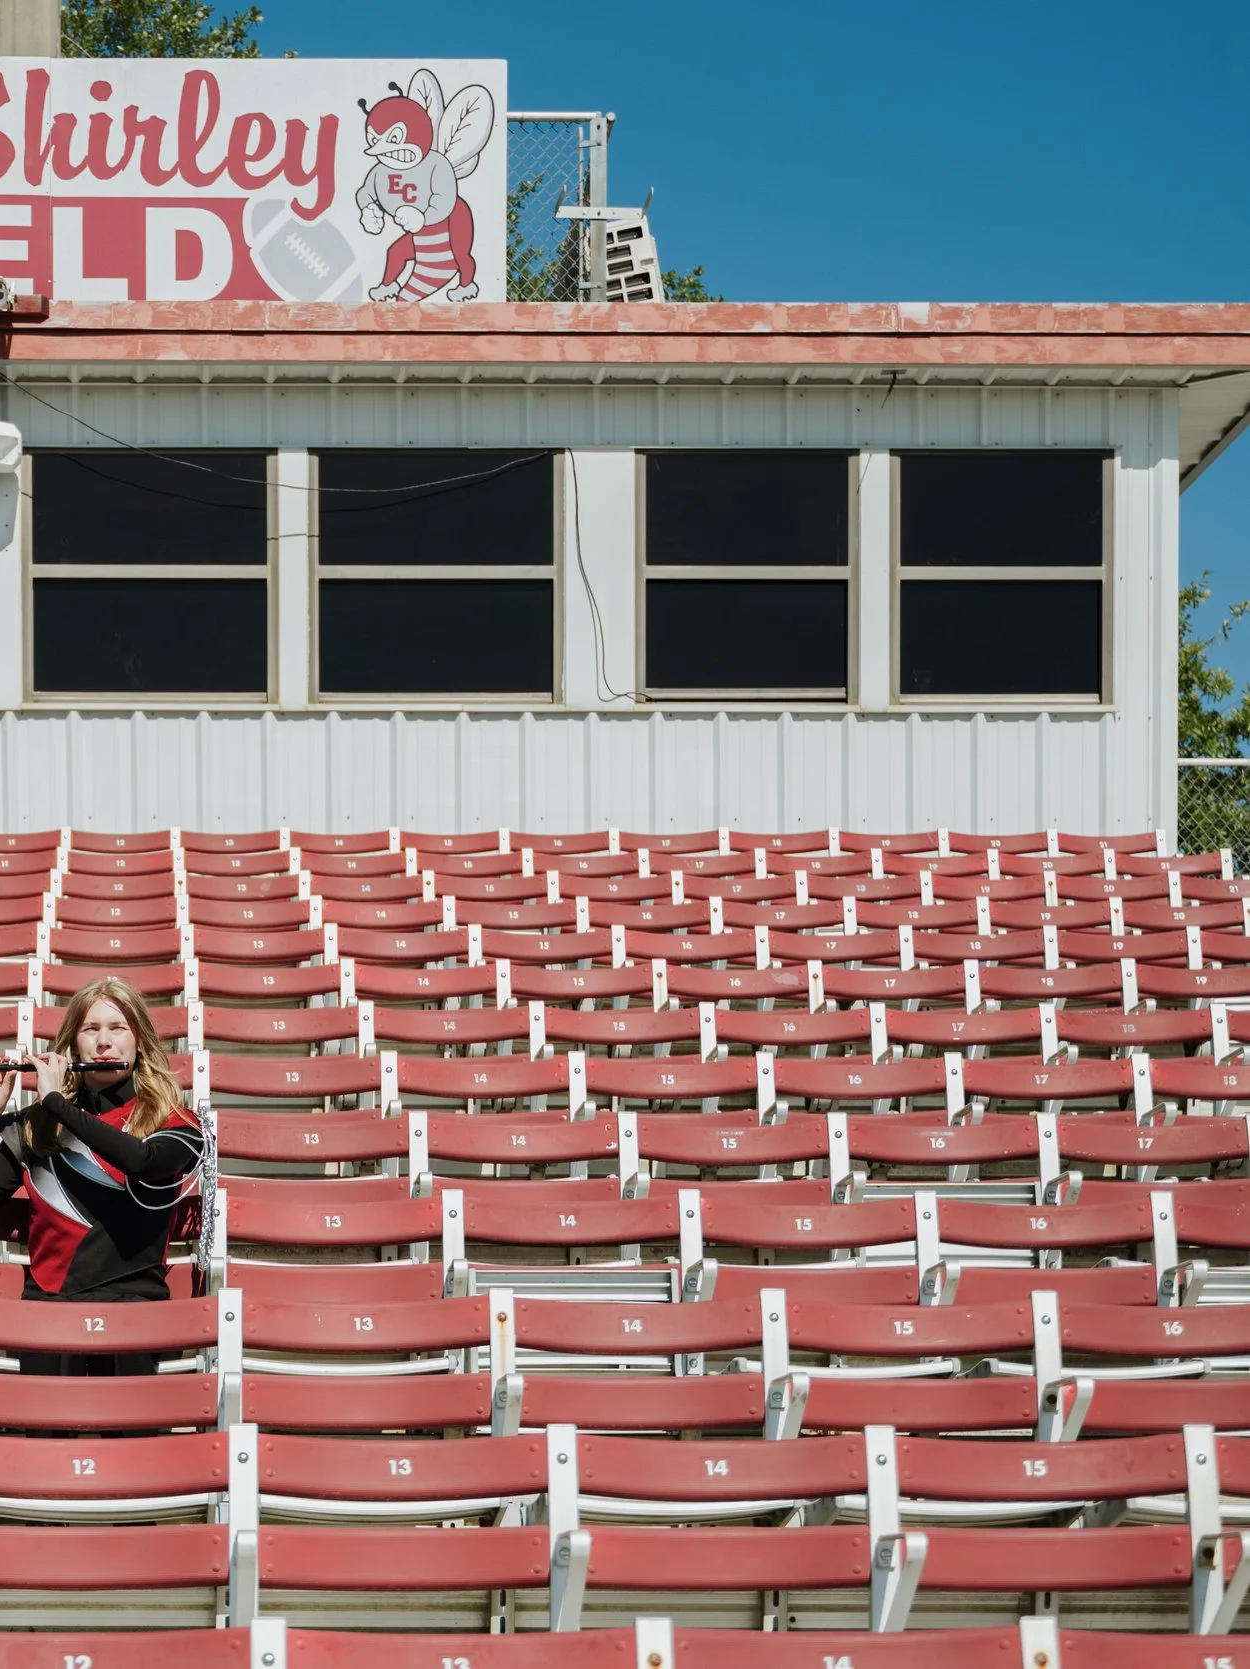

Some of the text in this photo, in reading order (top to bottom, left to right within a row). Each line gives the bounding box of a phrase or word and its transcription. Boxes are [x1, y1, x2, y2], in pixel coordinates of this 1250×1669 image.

[387, 174, 418, 203] EC
[110, 907, 121, 916] 12
[242, 910, 254, 919] 13
[375, 910, 387, 919] 14
[508, 911, 519, 920] 15
[641, 911, 653, 920] 16
[774, 911, 786, 920] 17
[907, 910, 919, 919] 18
[1040, 912, 1052, 921] 19
[109, 939, 121, 948] 12
[253, 940, 265, 949] 13
[395, 939, 407, 948] 14
[538, 941, 550, 950] 15
[681, 941, 693, 950] 16
[825, 941, 837, 950] 17
[969, 941, 982, 950] 18
[1112, 941, 1124, 951] 19
[262, 976, 275, 985] 13
[417, 977, 430, 987] 14
[573, 977, 585, 987] 15
[729, 977, 742, 987] 16
[884, 978, 896, 988] 17
[1195, 975, 1208, 985] 19
[272, 1020, 286, 1031] 13
[443, 1021, 457, 1031] 14
[612, 1021, 626, 1031] 15
[783, 1022, 796, 1033] 16
[951, 1022, 965, 1032] 17
[285, 1071, 300, 1083] 13
[473, 1073, 488, 1084] 14
[661, 1074, 675, 1085] 15
[847, 1074, 863, 1085] 16
[1034, 1074, 1049, 1085] 17
[1223, 1075, 1238, 1086] 18
[304, 1133, 320, 1145] 13
[510, 1135, 527, 1146] 14
[721, 1137, 737, 1149] 15
[929, 1137, 946, 1149] 16
[1137, 1137, 1154, 1149] 17
[324, 1215, 342, 1228] 13
[558, 1214, 577, 1227] 14
[795, 1218, 813, 1231] 15
[1029, 1217, 1048, 1230] 16
[84, 1317, 105, 1332] 12
[353, 1317, 374, 1331] 13
[622, 1319, 643, 1333] 14
[893, 1320, 914, 1336] 15
[1162, 1321, 1184, 1336] 16
[72, 1458, 96, 1475] 12
[388, 1458, 413, 1476] 13
[704, 1459, 729, 1477] 14
[1022, 1459, 1048, 1477] 15
[63, 1654, 92, 1669] 12
